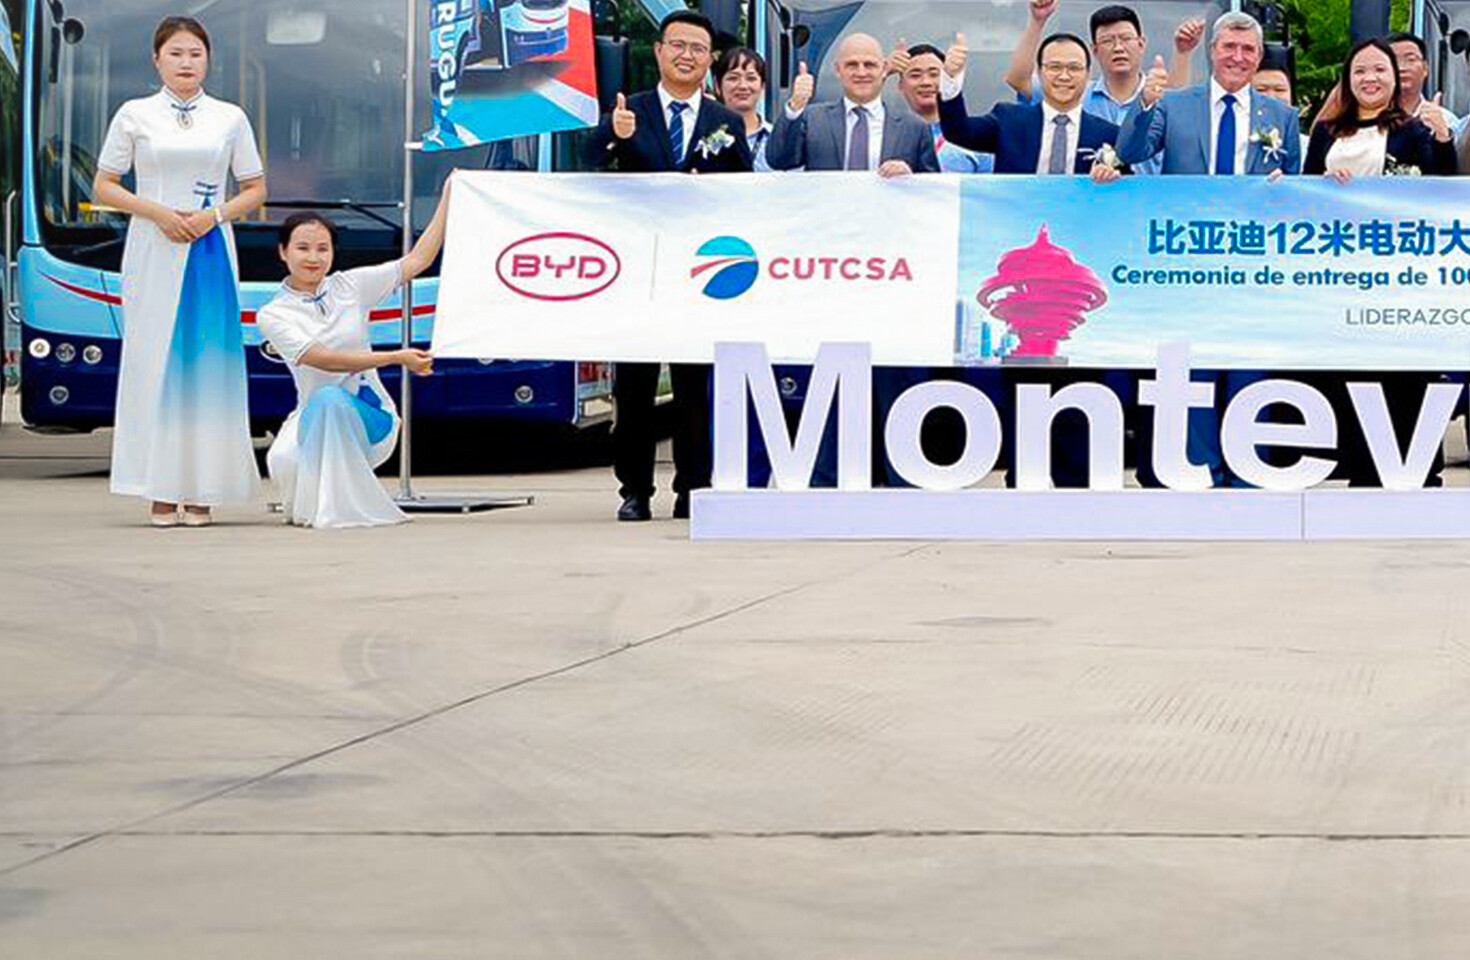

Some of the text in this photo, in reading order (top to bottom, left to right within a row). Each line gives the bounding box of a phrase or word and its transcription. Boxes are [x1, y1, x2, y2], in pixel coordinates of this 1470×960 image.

[511, 254, 608, 279] BYD
[768, 256, 913, 281] CUTCSA
[1111, 265, 1246, 286] Ceremonia
[1254, 265, 1285, 286] de
[1292, 267, 1390, 291] entrega
[1399, 265, 1429, 286] de
